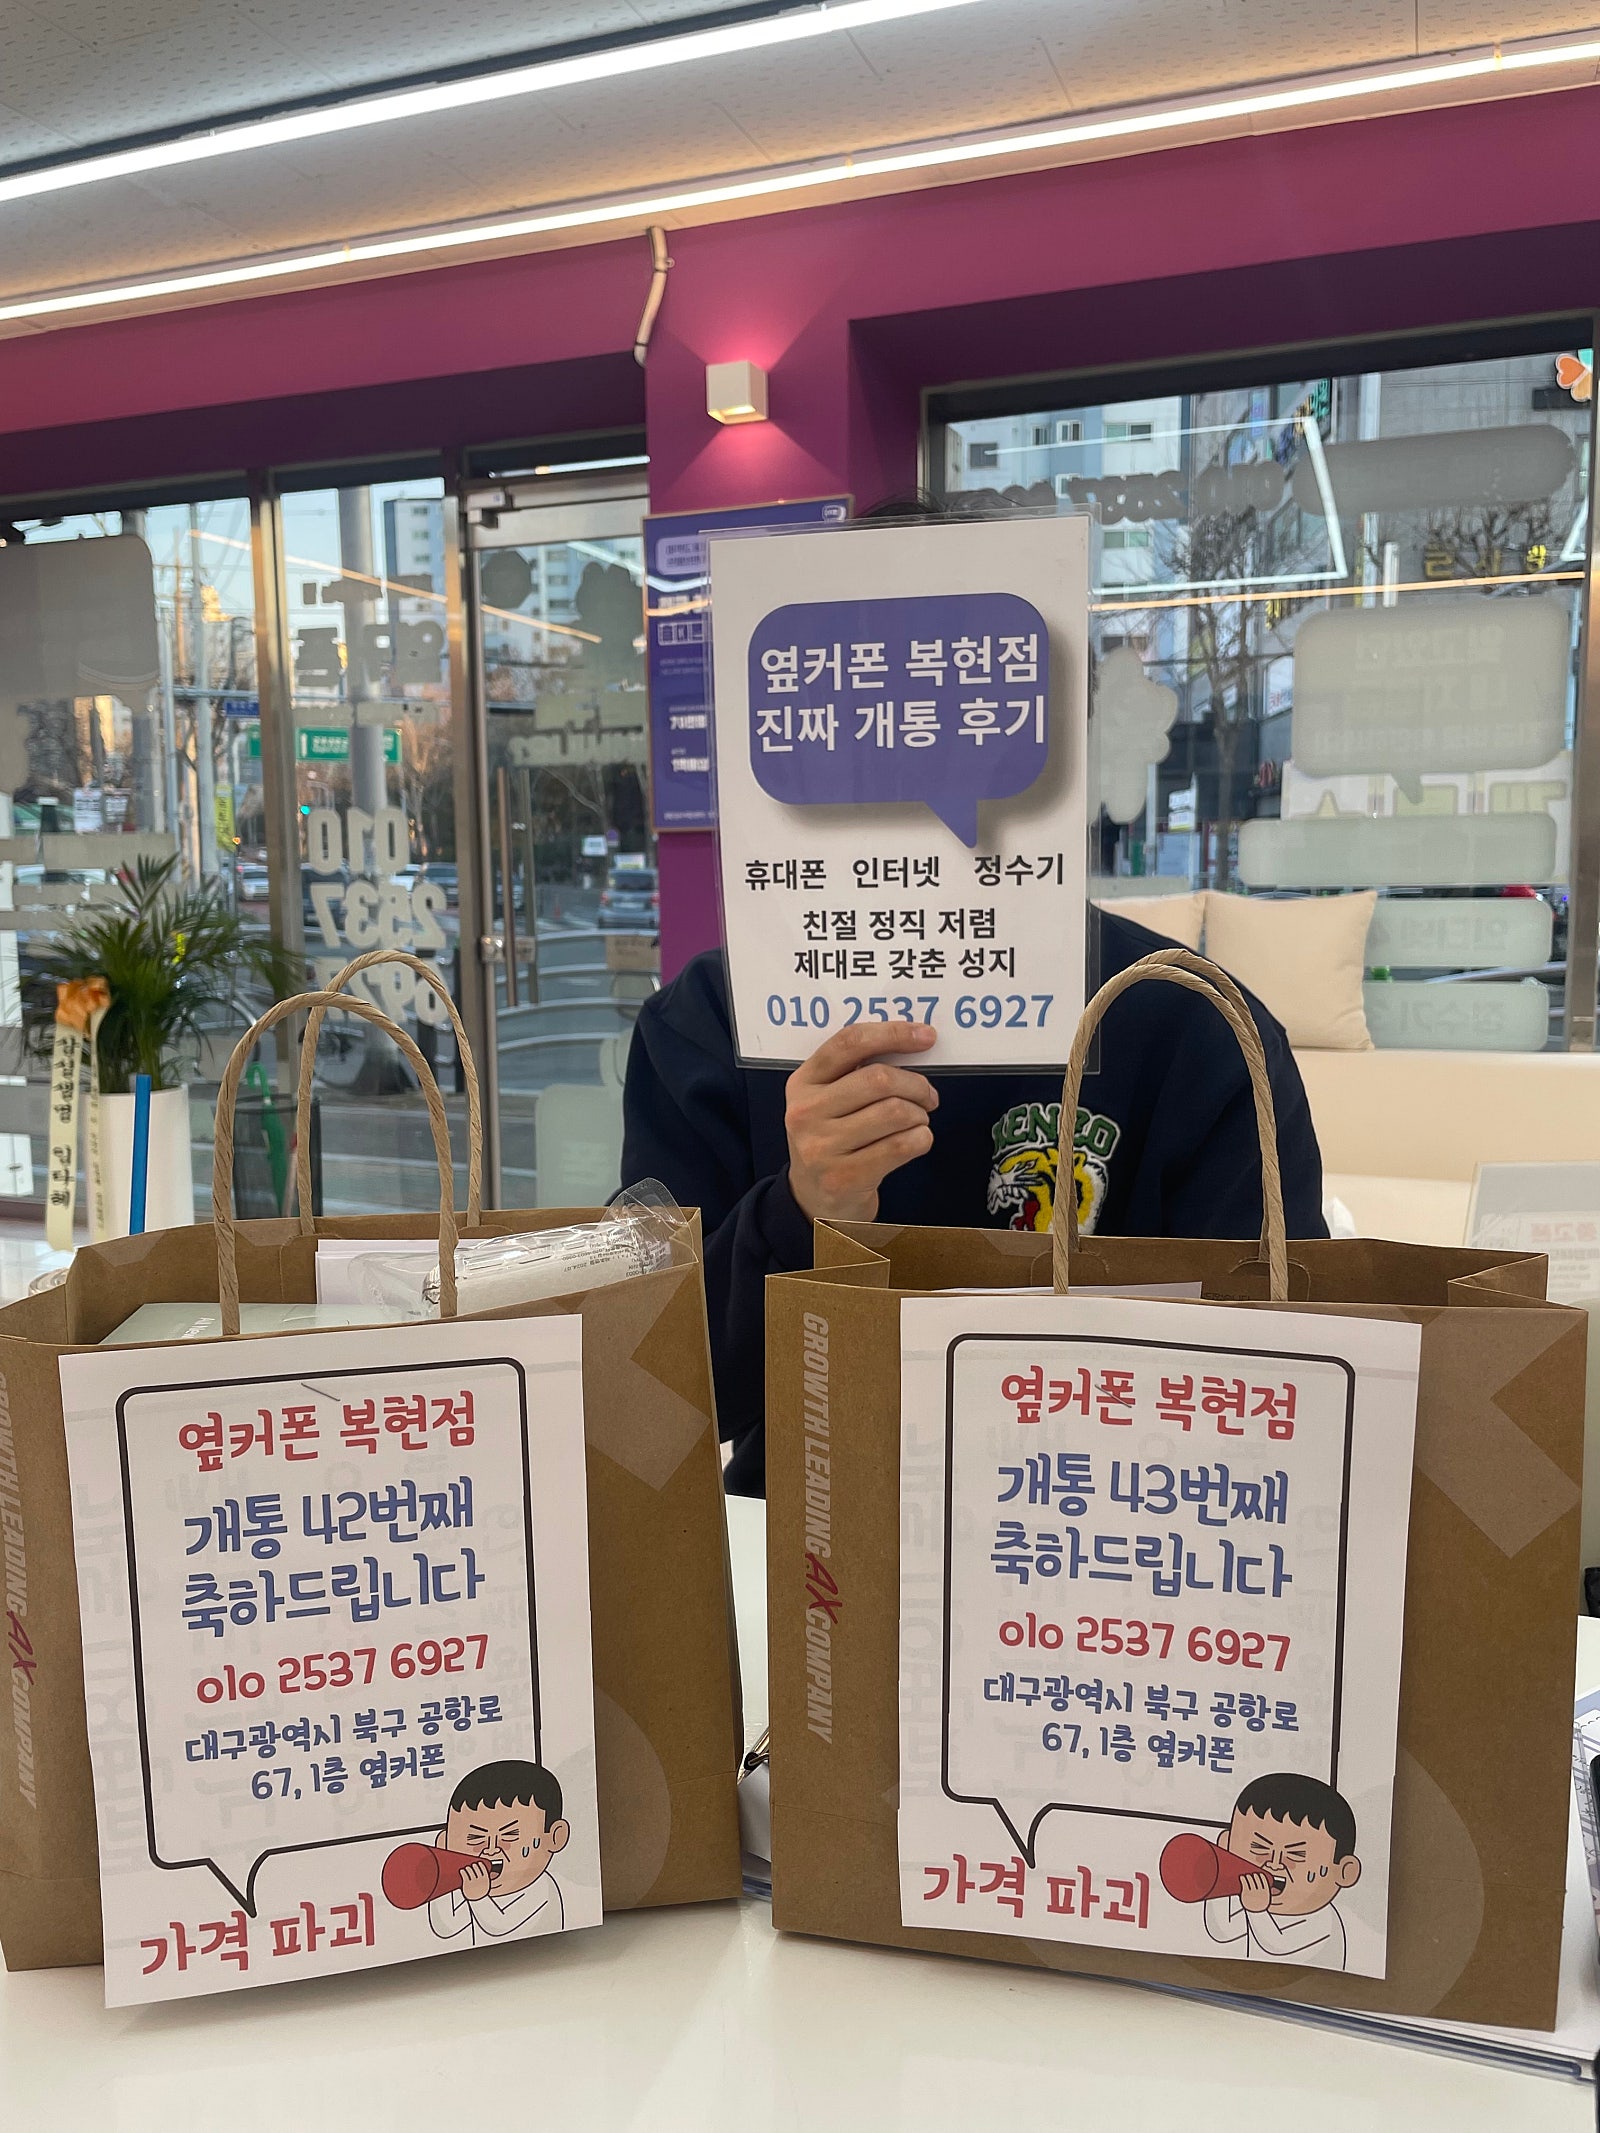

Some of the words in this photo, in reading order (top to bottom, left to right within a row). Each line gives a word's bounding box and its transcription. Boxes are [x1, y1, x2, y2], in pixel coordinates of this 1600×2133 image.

[762, 643, 888, 693] 옆커폰
[906, 634, 1037, 686] 복현점
[757, 704, 838, 752] 진짜
[855, 701, 940, 748] 개통
[958, 696, 1043, 745] 후기
[746, 860, 826, 890] 휴대폰
[853, 856, 939, 888] 인터넷
[975, 854, 1062, 886] 정수기
[804, 911, 856, 940] 친절
[870, 910, 924, 940] 정직
[939, 908, 994, 939] 저렴
[795, 950, 877, 979] 제대로
[889, 949, 946, 979] 갖춘
[959, 947, 1014, 978] 성지
[768, 995, 829, 1028] 010
[843, 996, 939, 1027] 2537
[955, 995, 1053, 1028] 6927
[803, 1311, 830, 1438] GROWTH
[1002, 1365, 1135, 1425] 옆커폰
[1156, 1375, 1296, 1440] 복현점
[179, 1406, 319, 1472] 옆커폰
[340, 1391, 474, 1454] 복현점
[185, 1494, 287, 1559] 개통
[303, 1476, 473, 1544] 42번째
[804, 1435, 832, 1559] LEADING
[998, 1453, 1095, 1516] 개통
[1110, 1461, 1288, 1526] 43번째
[182, 1548, 485, 1637] 축하드립니다
[991, 1523, 1292, 1597] 축하드립니다
[278, 1648, 376, 1693] 2537
[391, 1635, 488, 1678] 6927
[805, 1608, 834, 1745] COMPANY
[1078, 1617, 1174, 1658] 2537
[1188, 1626, 1290, 1671] 6927
[186, 1716, 341, 1763] 대구광역시
[353, 1709, 406, 1743] 북구
[418, 1696, 502, 1735] 공항로
[984, 1672, 1132, 1714] 대구광역시
[1145, 1684, 1198, 1721] 북구
[1210, 1692, 1299, 1732] 공항로
[11, 1667, 36, 1809] COMPANY
[252, 1768, 301, 1799] 67,
[310, 1759, 348, 1794] 1층
[360, 1744, 445, 1788] 옆커폰
[1043, 1723, 1089, 1758] 67,
[1100, 1724, 1136, 1762] 1층
[1148, 1730, 1234, 1773] 옆커폰
[924, 1855, 1026, 1918] 가격
[1047, 1866, 1149, 1928] 파괴
[141, 1910, 250, 1974] 가격
[270, 1893, 374, 1956] 파괴
